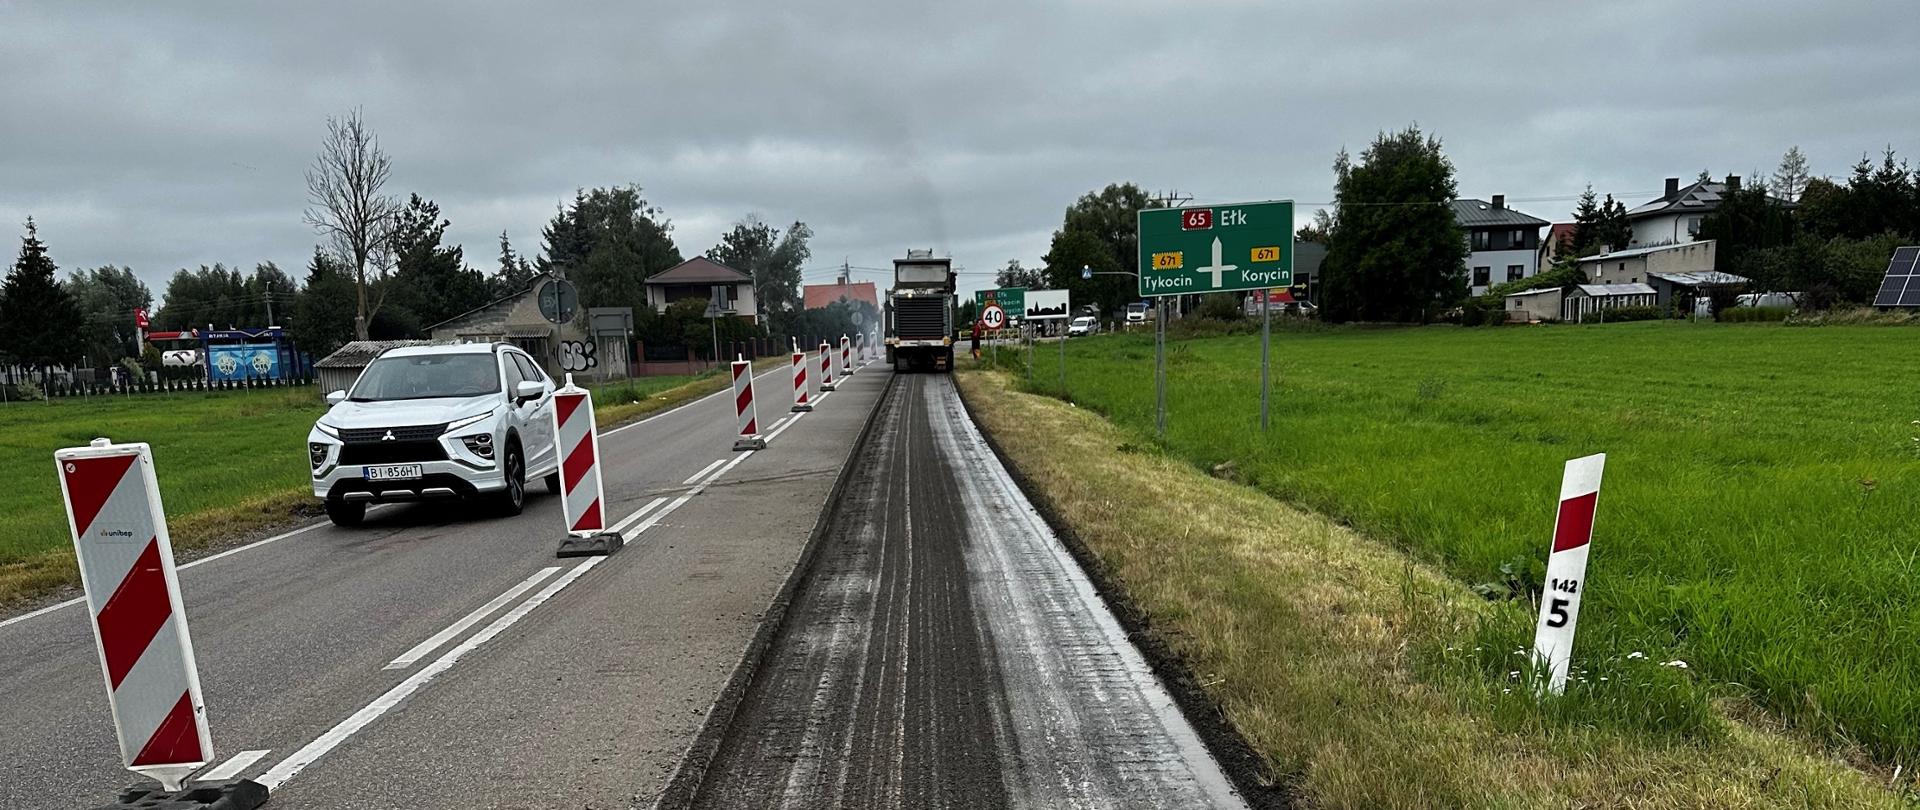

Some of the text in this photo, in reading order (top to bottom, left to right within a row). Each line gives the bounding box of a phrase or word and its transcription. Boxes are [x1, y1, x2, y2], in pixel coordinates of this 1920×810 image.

[1188, 209, 1247, 226] 65 Ełk
[1160, 256, 1176, 266] 671
[1257, 249, 1273, 259] 671
[1143, 274, 1192, 291] Tykocin
[1241, 267, 1289, 284] Korycin
[984, 311, 1002, 323] 40
[370, 465, 418, 478] BI 856HT
[108, 529, 133, 538] unibep
[1551, 578, 1578, 594] 142
[1546, 598, 1569, 628] 5
